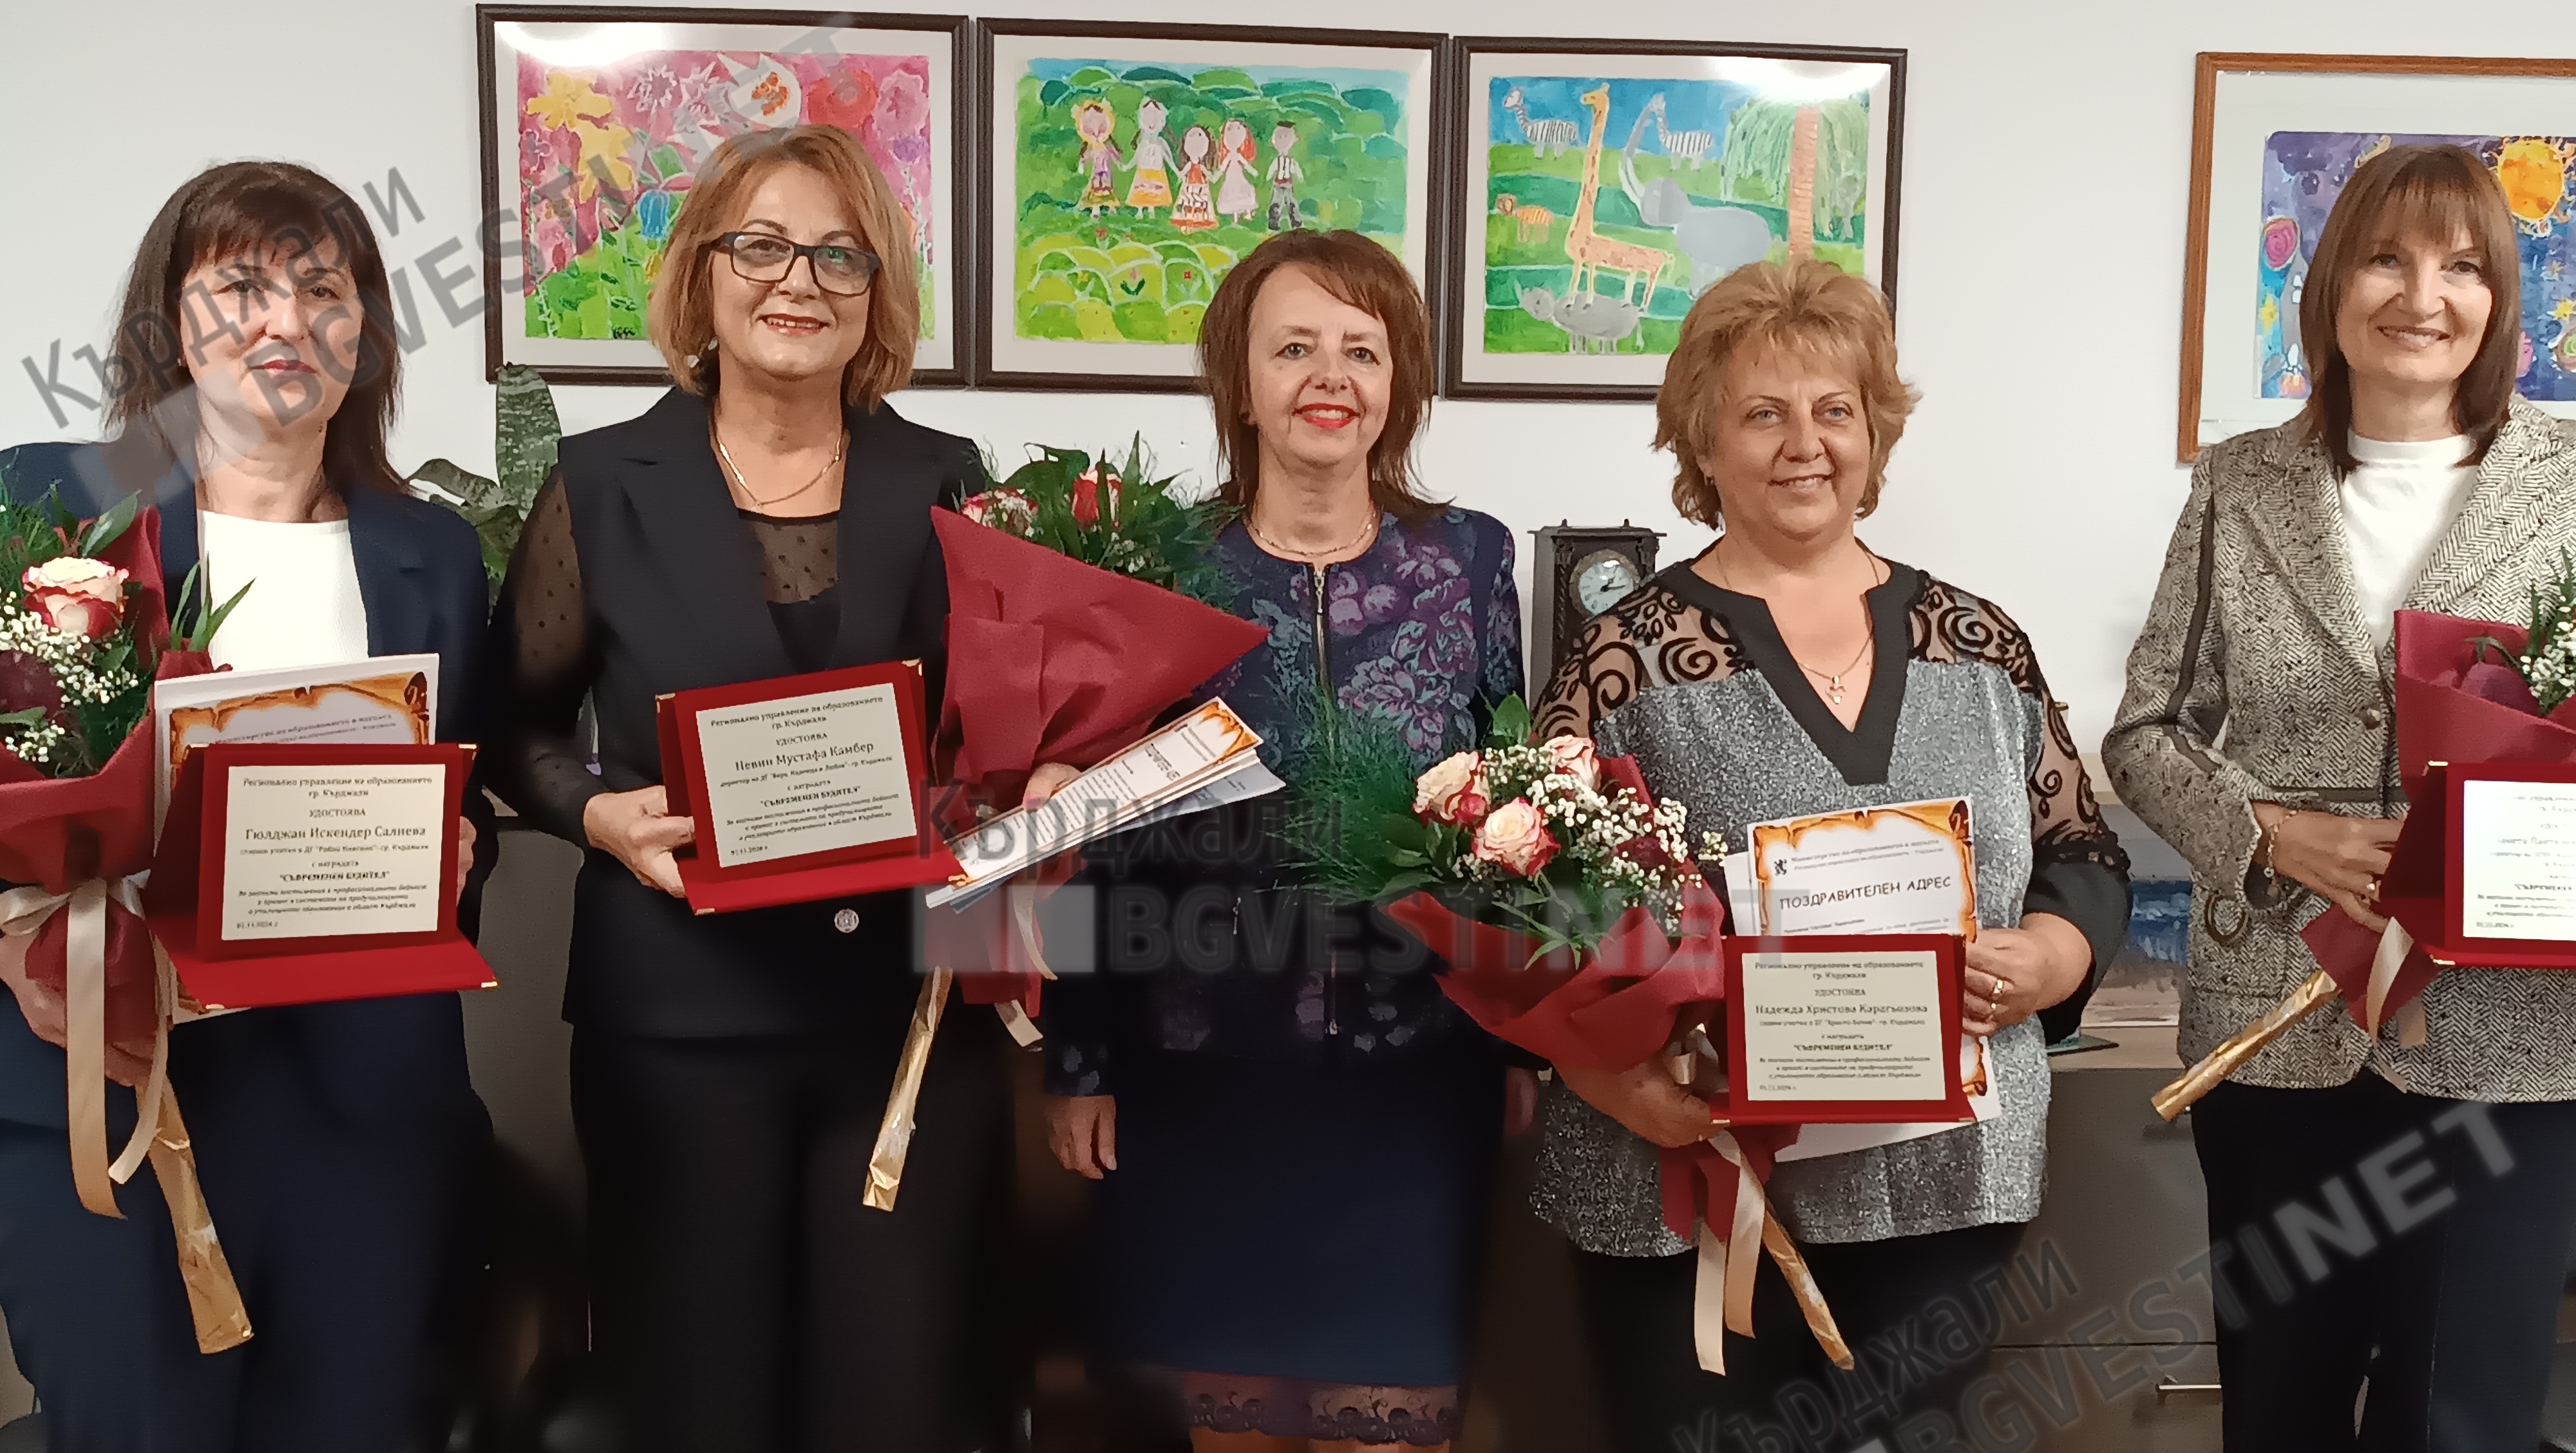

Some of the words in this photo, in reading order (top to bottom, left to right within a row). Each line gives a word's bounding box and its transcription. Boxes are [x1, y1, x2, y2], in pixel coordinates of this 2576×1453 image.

[776, 749, 827, 766] Мустафа
[829, 741, 875, 755] Камбер
[245, 828, 306, 840] Гюлджан
[310, 827, 372, 840] Искендер
[1779, 881, 1900, 910] ПОЗДРАВИТЕЛЕН
[1906, 875, 1951, 891] АДРЕС
